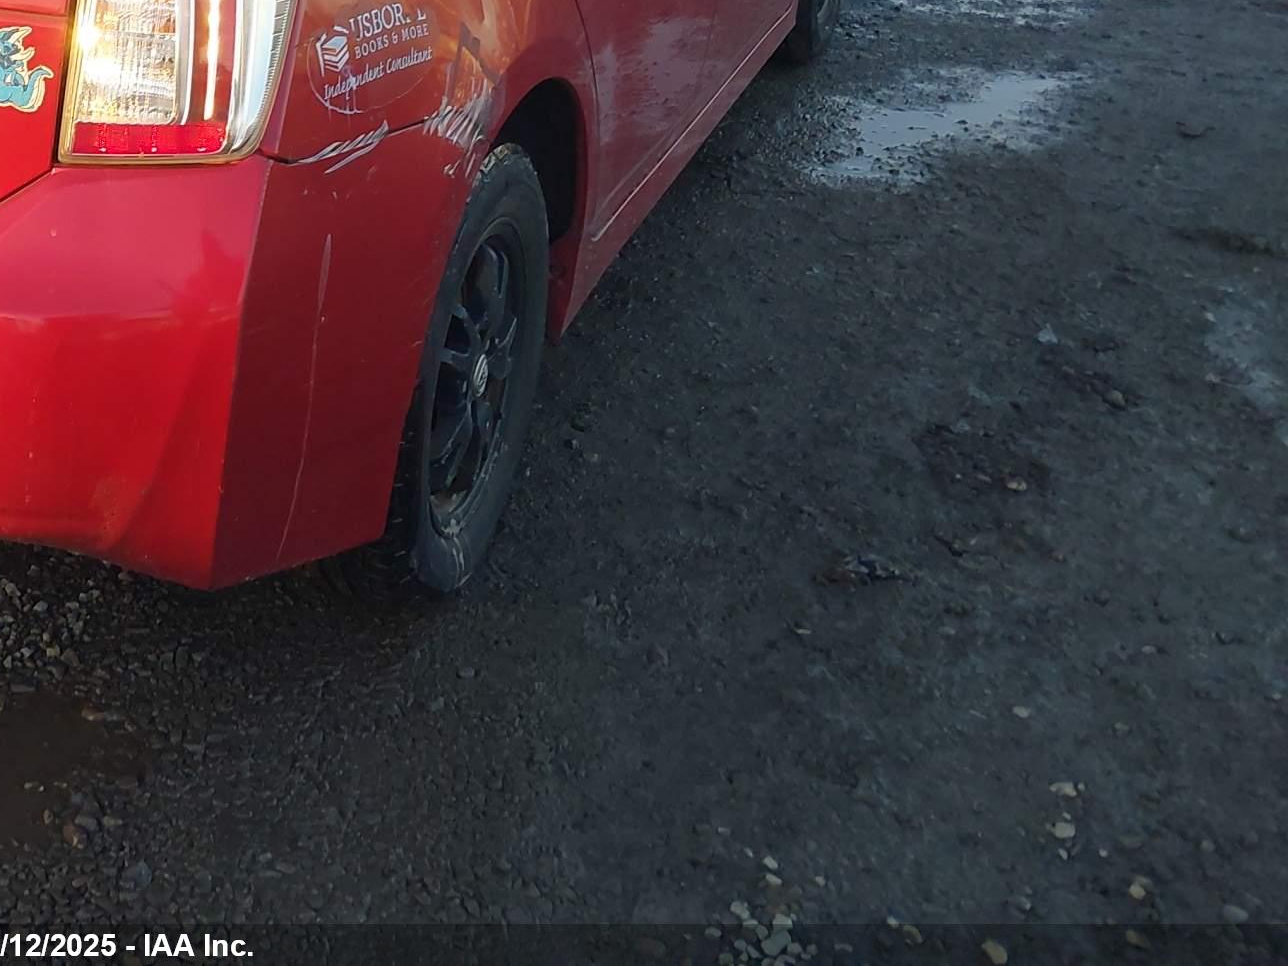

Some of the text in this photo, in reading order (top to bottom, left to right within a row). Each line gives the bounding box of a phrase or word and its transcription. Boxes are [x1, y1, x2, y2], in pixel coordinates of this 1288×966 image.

[354, 23, 429, 59] BOOKS & MORE
[386, 45, 433, 74] Consultant
